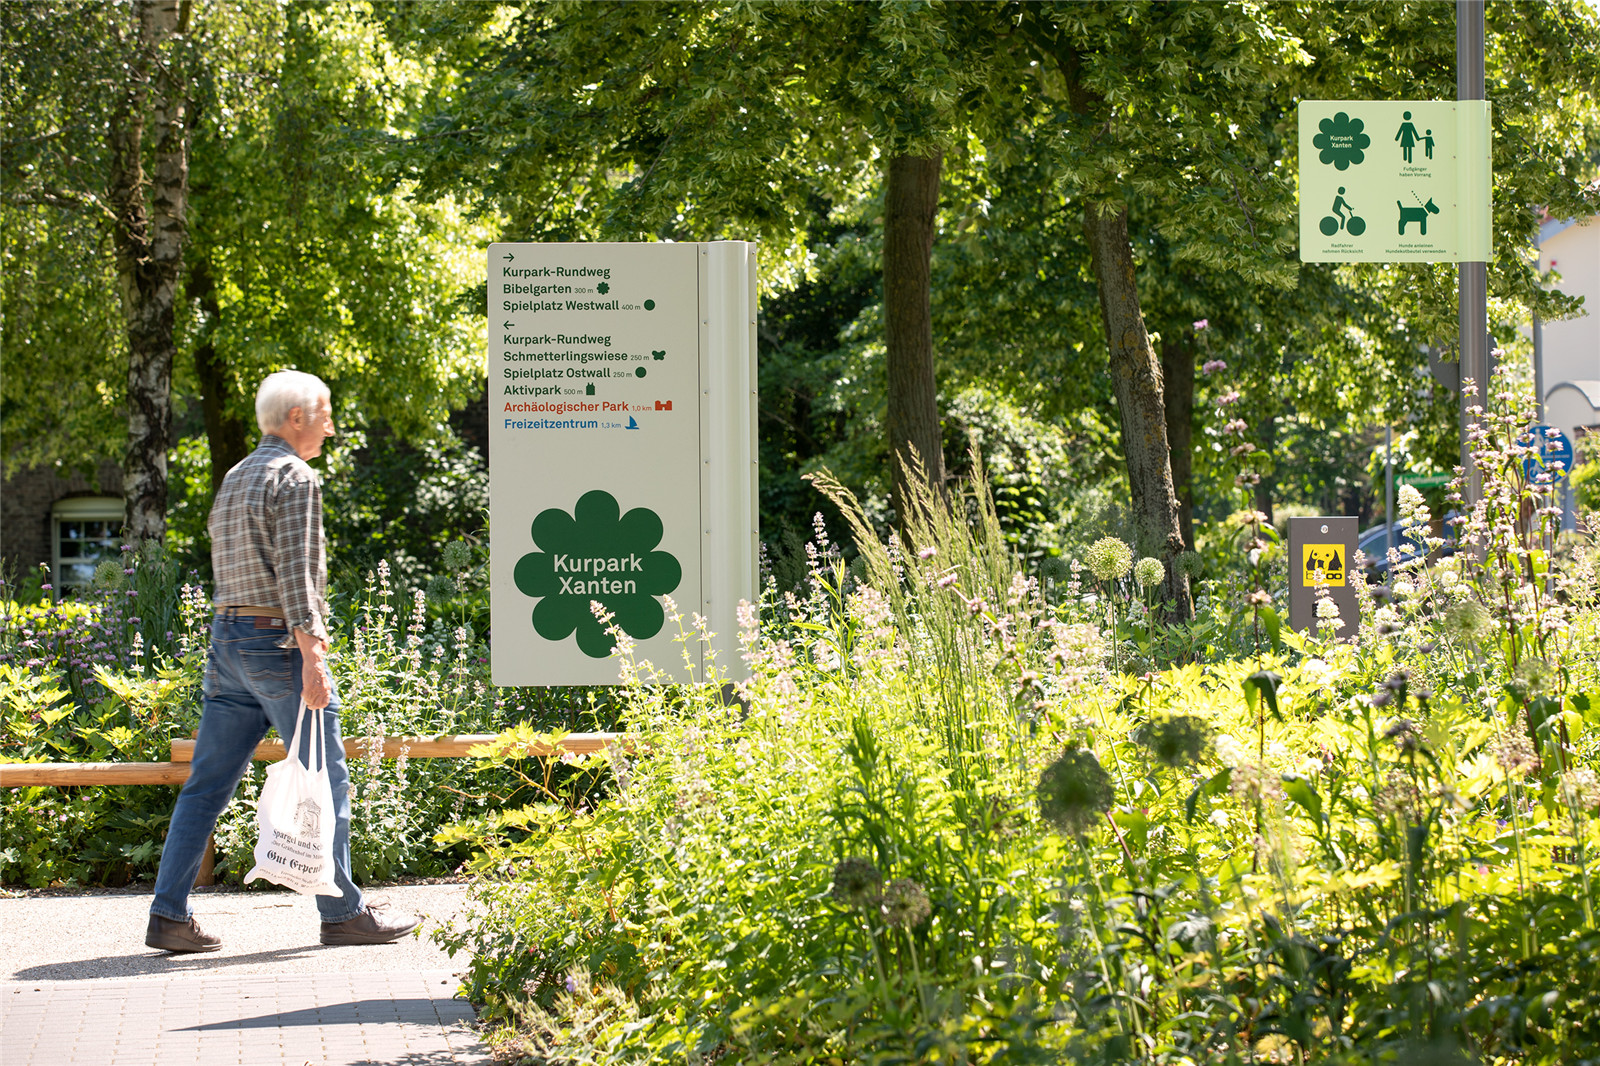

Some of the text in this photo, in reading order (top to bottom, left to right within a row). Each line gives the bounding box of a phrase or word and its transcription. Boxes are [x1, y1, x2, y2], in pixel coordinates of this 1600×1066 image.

[503, 267, 610, 279] Kurpark-Rundweg
[503, 283, 572, 296] Bibelgarten
[503, 300, 563, 313] Spielplatz
[566, 300, 619, 311] Westwall
[504, 334, 611, 346] Kurpark-Rundweg
[504, 351, 628, 363] Schmetterlingswiese
[504, 368, 563, 380] Spielplatz
[566, 368, 610, 378] Ostwall
[504, 385, 561, 397] Aktivpark
[504, 402, 599, 414] Archäologischer
[602, 402, 629, 412] Park
[504, 419, 598, 429] Freizeitzentrum
[554, 553, 643, 576] Kurpark
[559, 576, 636, 594] Xanten
[273, 829, 296, 844] Spargel
[298, 841, 310, 849] und
[267, 850, 287, 864] Gut
